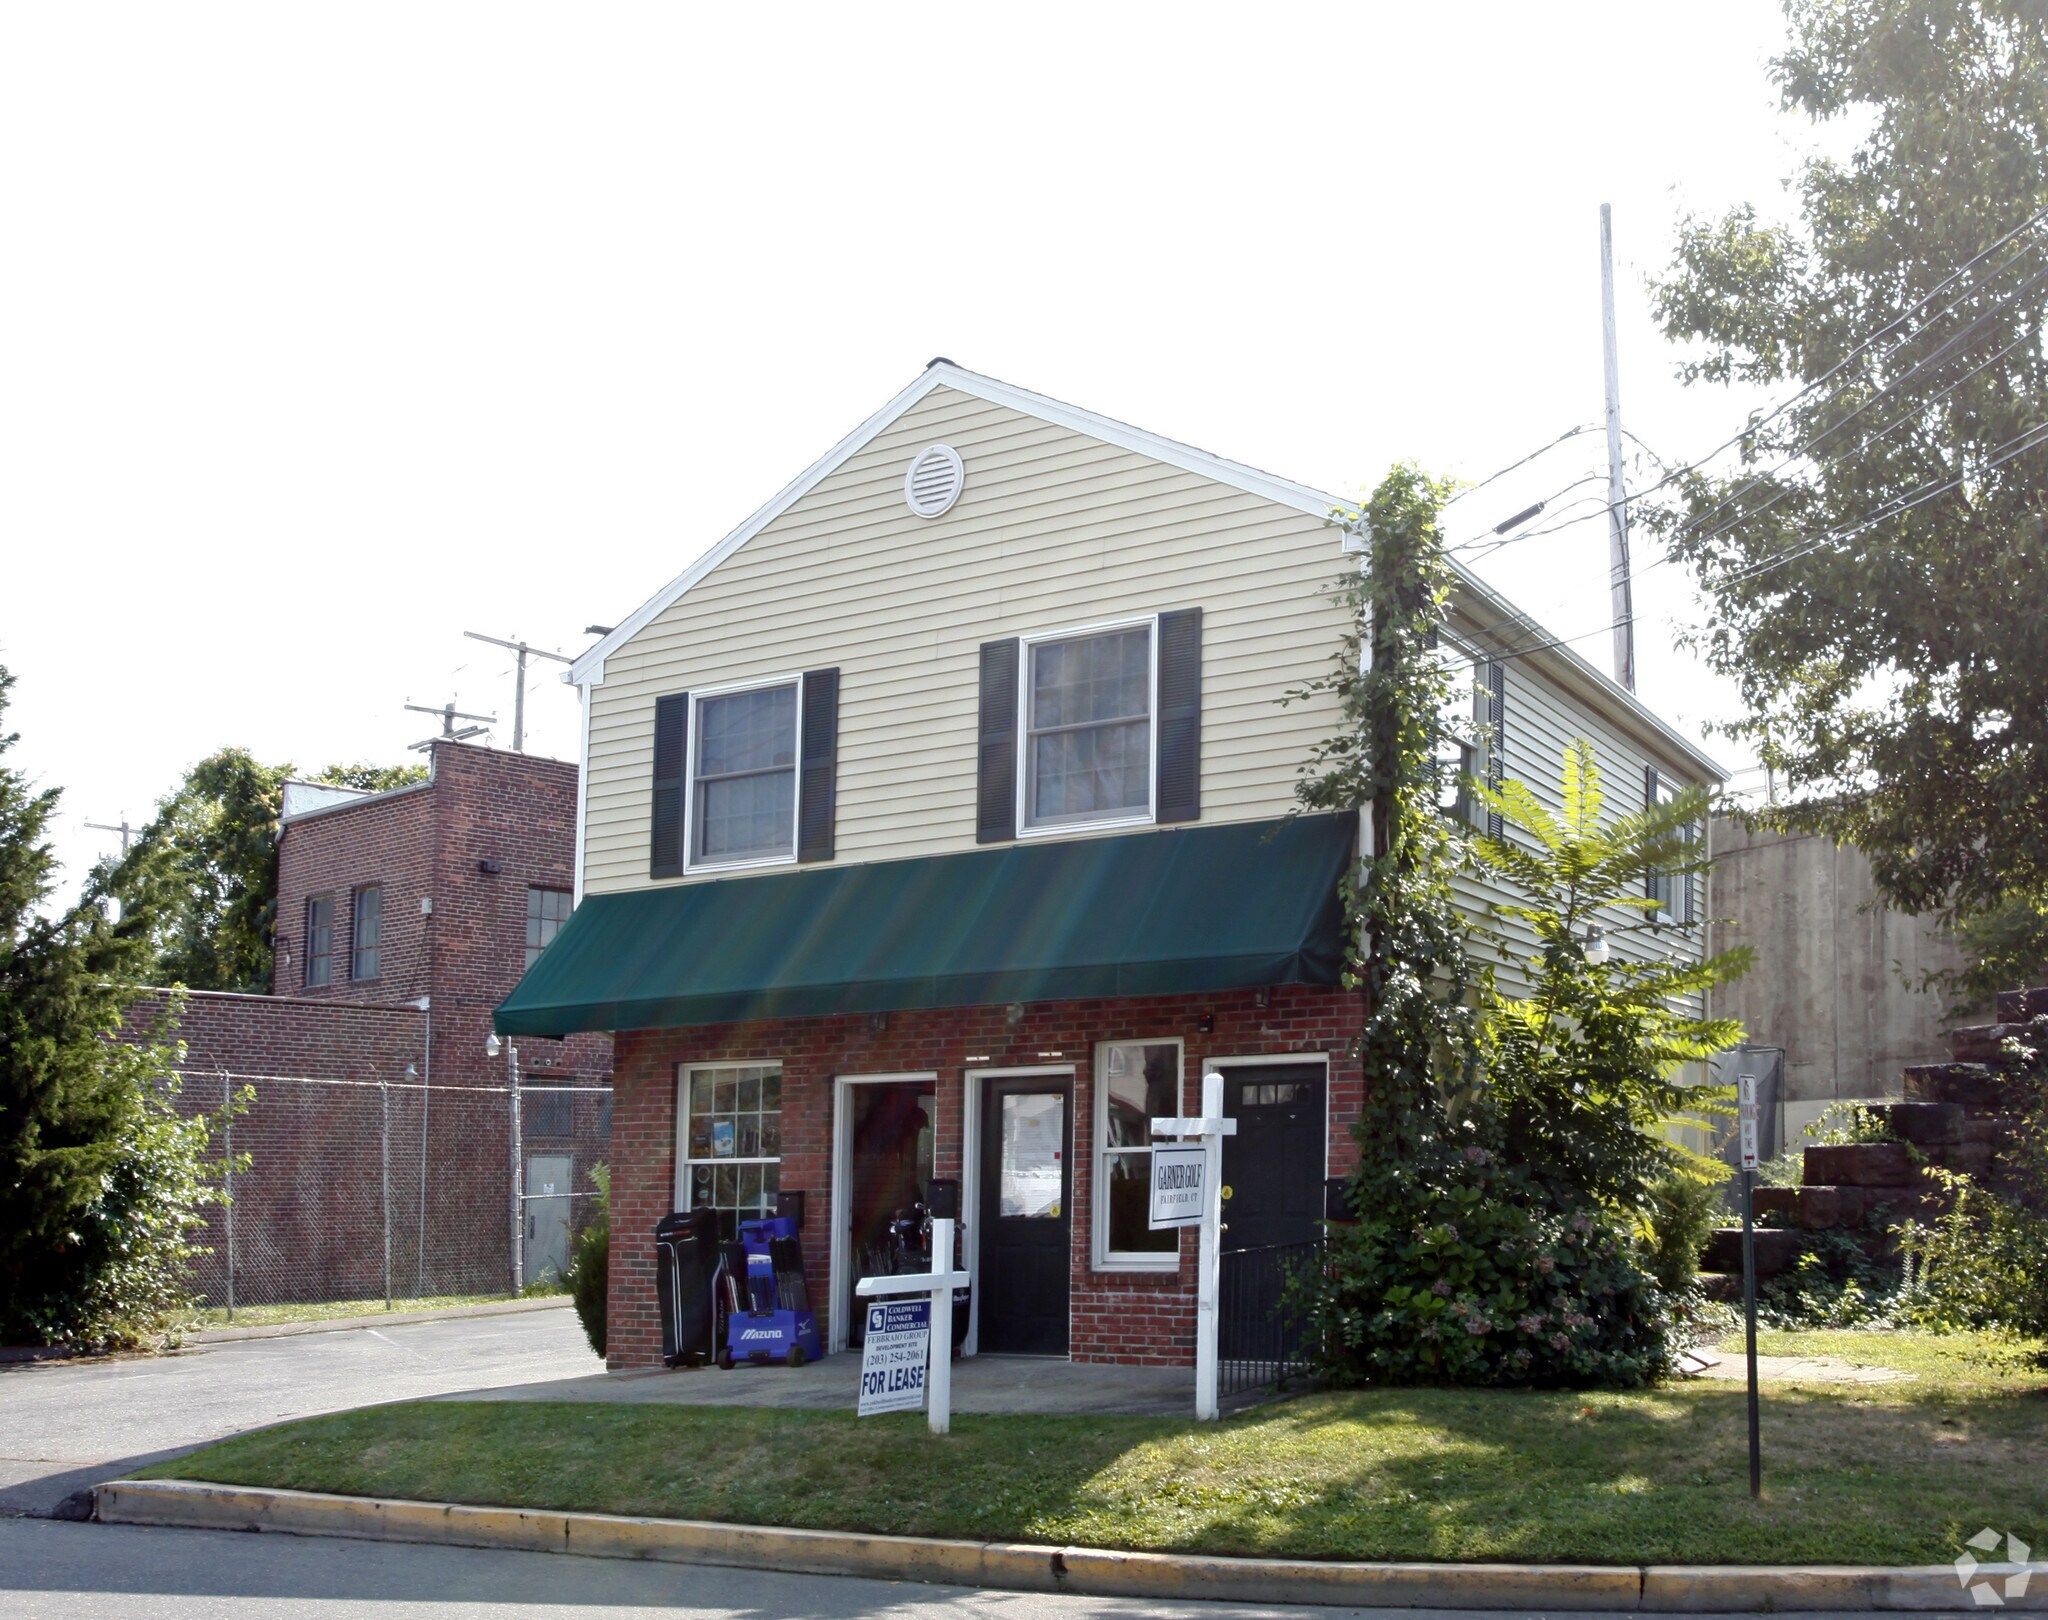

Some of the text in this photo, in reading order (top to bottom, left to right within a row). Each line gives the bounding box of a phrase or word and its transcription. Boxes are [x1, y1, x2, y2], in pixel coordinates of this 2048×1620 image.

[1158, 1164, 1202, 1190] GARNER GOLF
[1160, 1193, 1198, 1204] FAIRFIELD CT
[888, 1305, 922, 1314] COLDWELL
[887, 1314, 913, 1323] BANKER
[886, 1322, 928, 1331] COMMERCIAL
[867, 1331, 927, 1344] FEBBRAIO GROUP
[876, 1343, 907, 1351] DEVELOPMENT
[867, 1350, 923, 1367] (203) 254-2061
[861, 1365, 924, 1396] FOR LEASE
